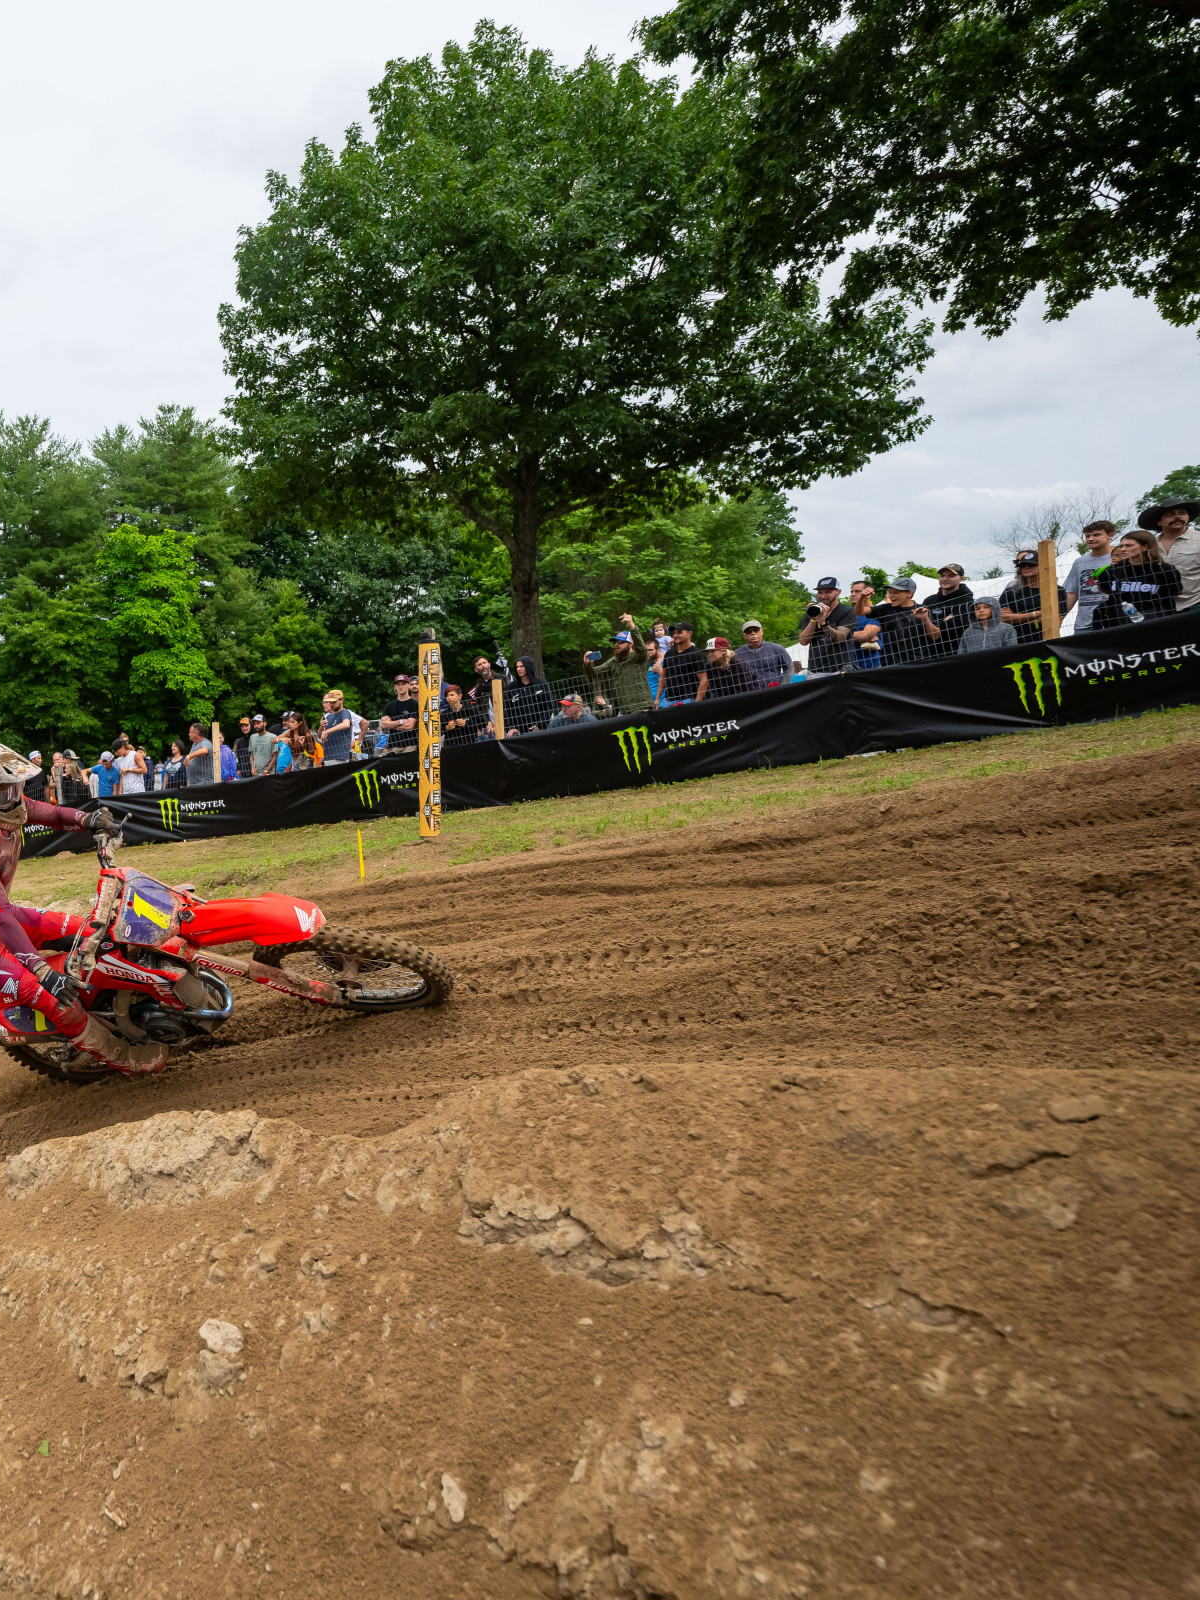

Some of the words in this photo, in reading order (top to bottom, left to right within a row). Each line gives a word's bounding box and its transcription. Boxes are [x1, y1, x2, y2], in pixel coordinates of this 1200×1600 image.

[431, 648, 439, 664] THE
[1064, 643, 1200, 679] MONSTER
[429, 663, 440, 691] WICK
[1088, 663, 1183, 685] ENERGY
[431, 695, 439, 711] THE
[430, 710, 440, 738] WICK
[653, 719, 741, 744] MONSTER
[432, 742, 440, 758] THE
[668, 734, 728, 750] ENERGY
[380, 771, 419, 785] MONST
[430, 757, 440, 785] WICK
[180, 799, 226, 812] MONSTER
[188, 809, 220, 817] ENERGY
[133, 891, 171, 930] 1
[309, 908, 317, 934] HONDA
[103, 966, 157, 983] HONDA
